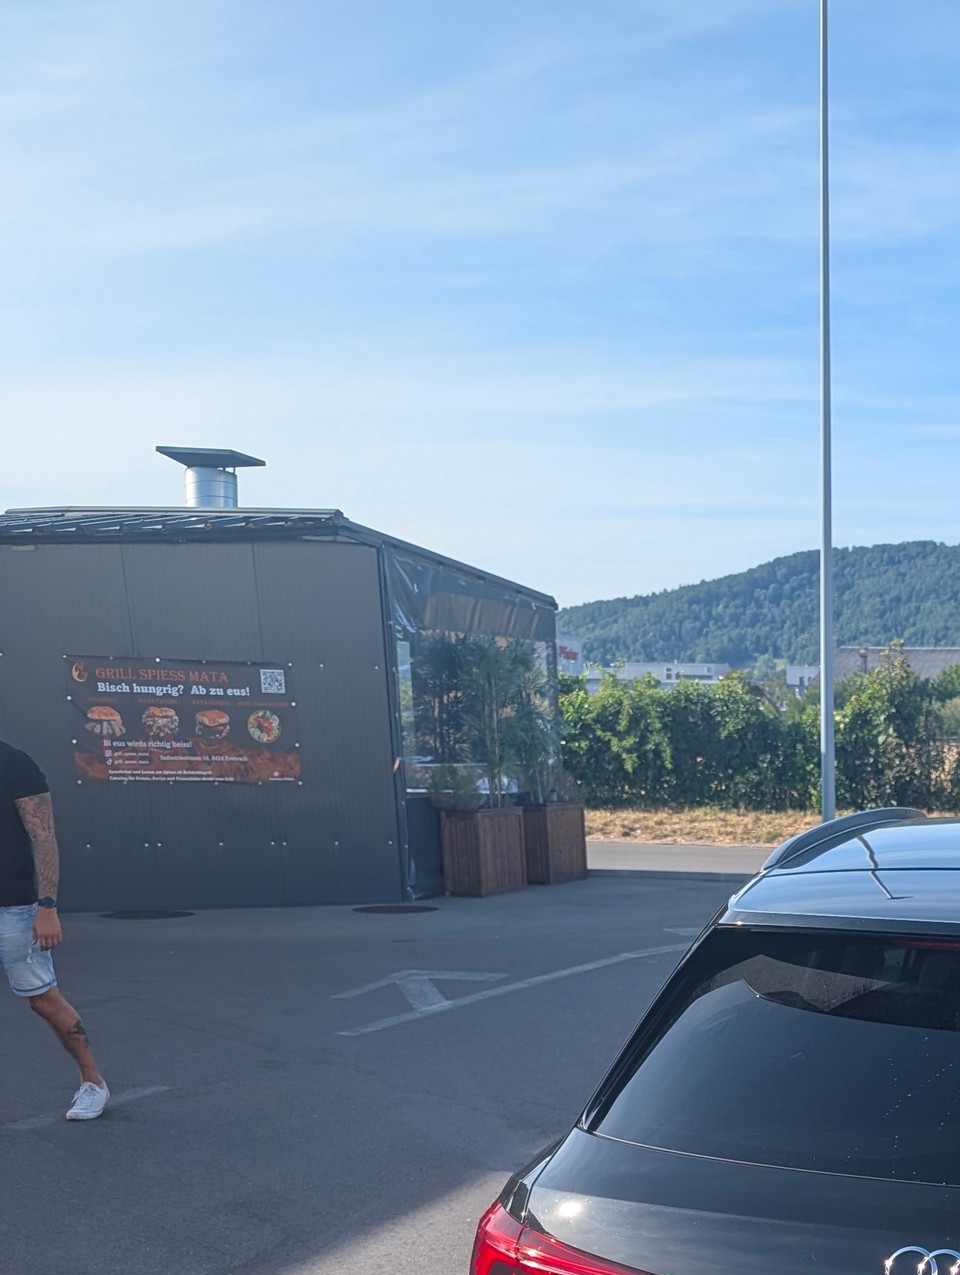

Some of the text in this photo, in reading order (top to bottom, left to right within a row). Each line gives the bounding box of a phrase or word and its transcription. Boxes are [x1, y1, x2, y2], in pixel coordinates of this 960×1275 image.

[96, 668, 229, 683] GRILL SPIESS MATA
[97, 682, 250, 696] Bisch hungrig? Ab zu eus!
[127, 740, 147, 748] wirds
[148, 740, 171, 749] richtig
